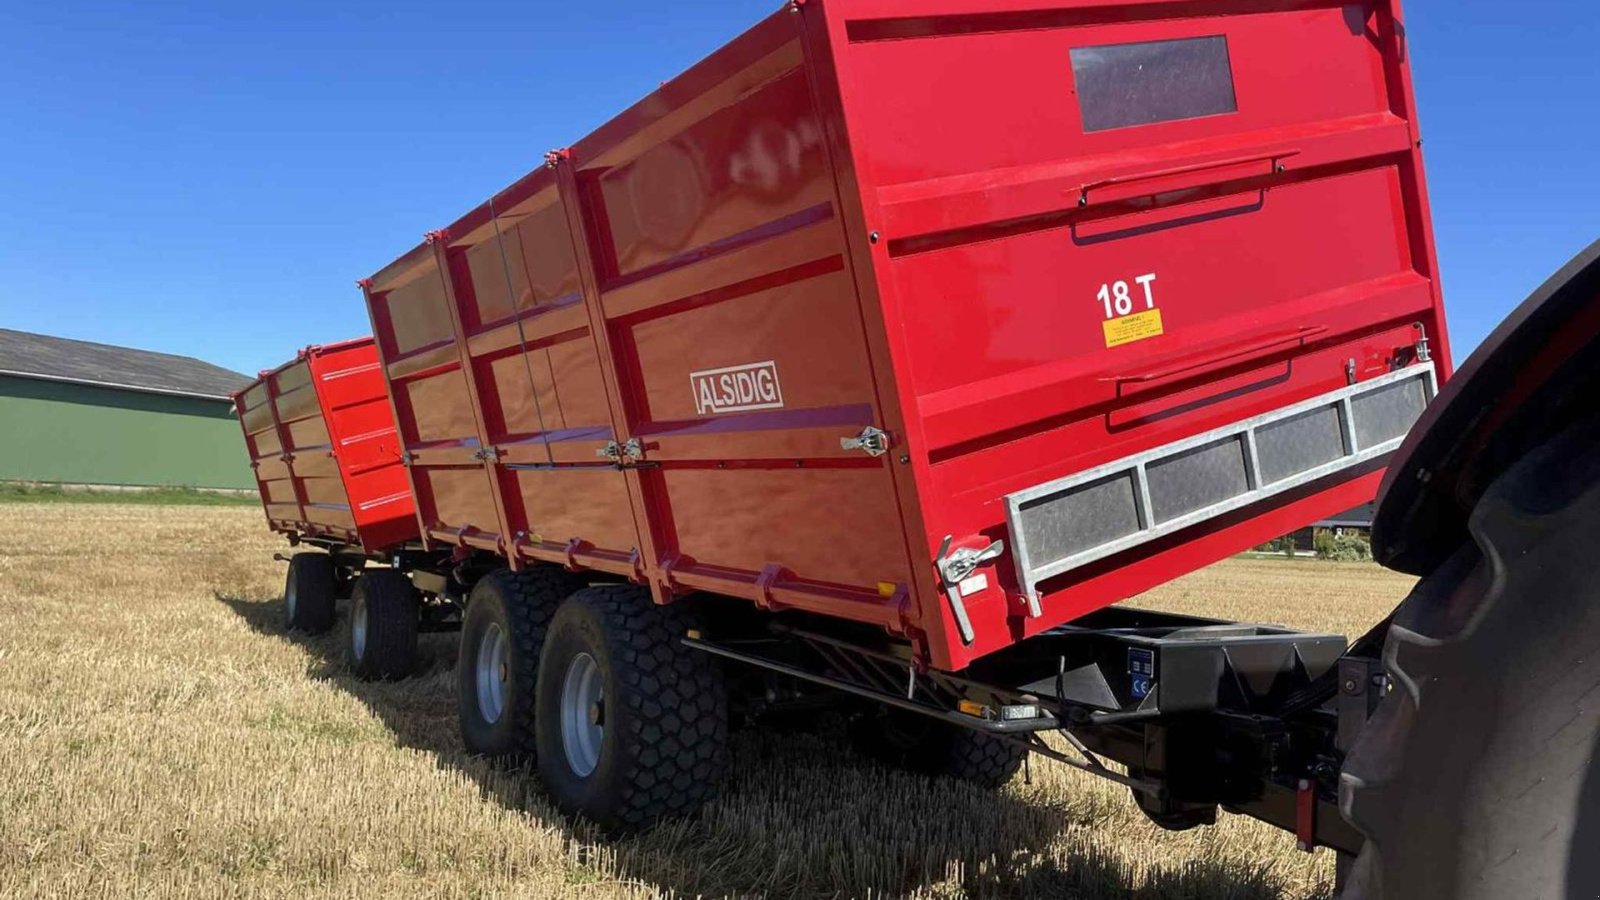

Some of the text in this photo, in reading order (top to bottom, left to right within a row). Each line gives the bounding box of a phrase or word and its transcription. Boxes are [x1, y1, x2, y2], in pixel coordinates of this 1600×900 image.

[1097, 273, 1156, 318] 18 T
[699, 368, 777, 414] ALSIDIG
[1133, 679, 1147, 694] CE
